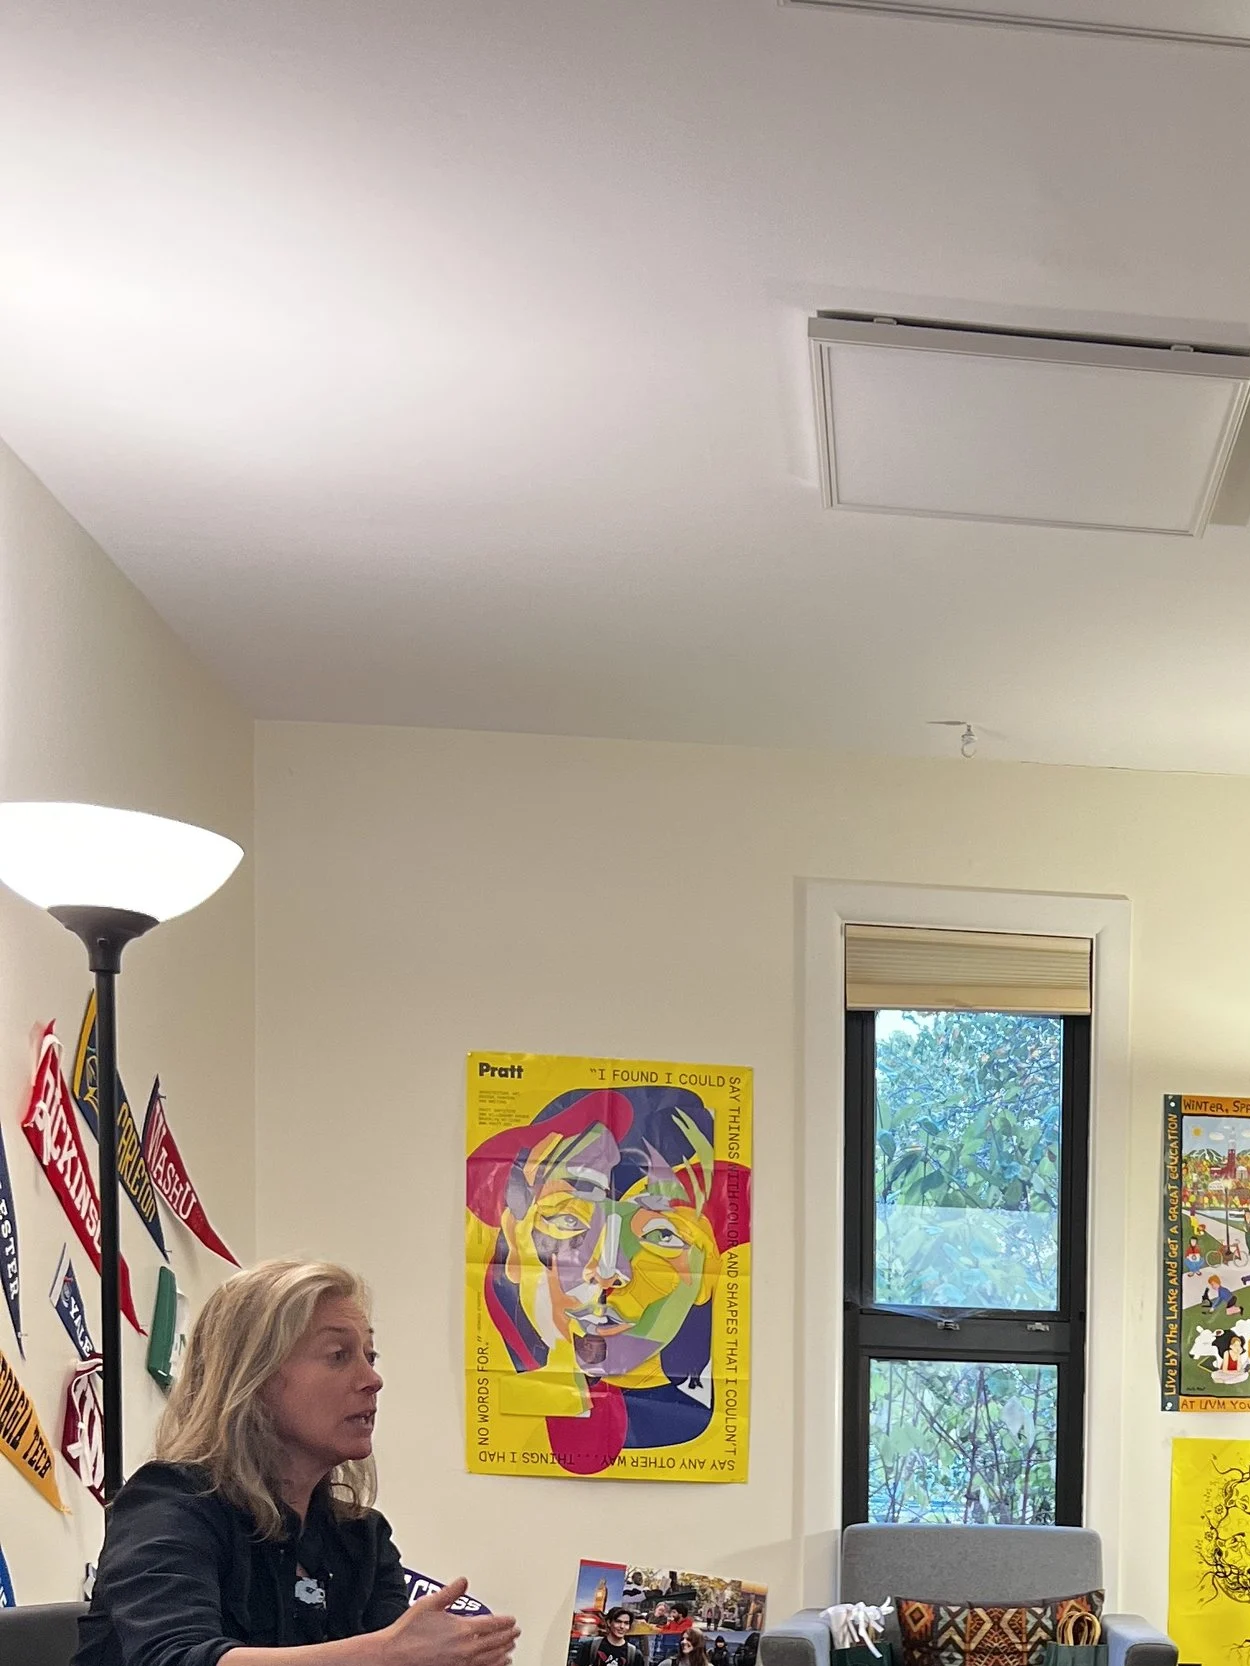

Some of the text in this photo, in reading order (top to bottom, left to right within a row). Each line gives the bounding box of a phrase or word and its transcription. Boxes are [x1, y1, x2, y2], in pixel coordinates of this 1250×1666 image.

[479, 1062, 524, 1079] Pratt
[612, 1070, 659, 1083] FOUND
[665, 1073, 672, 1084] I
[679, 1073, 726, 1088] COULD
[729, 1076, 741, 1101] SAY
[728, 1107, 741, 1159] THINGS
[117, 1101, 157, 1223] CARLETON
[147, 1100, 198, 1220] WASHU
[727, 1201, 740, 1248] COLOR
[726, 1251, 739, 1278] AND
[726, 1283, 739, 1336] SHAPES
[725, 1340, 738, 1373] THAT
[477, 1377, 489, 1424] WORDS
[1181, 1399, 1195, 1409] AT
[724, 1389, 737, 1455] COULDN'T
[477, 1427, 489, 1445] NO
[22, 1423, 52, 1479] TECH
[479, 1450, 505, 1463] HAD
[510, 1451, 516, 1463] I
[631, 1456, 676, 1469] OTHER
[679, 1457, 706, 1470] ANY
[710, 1459, 736, 1471] SAY
